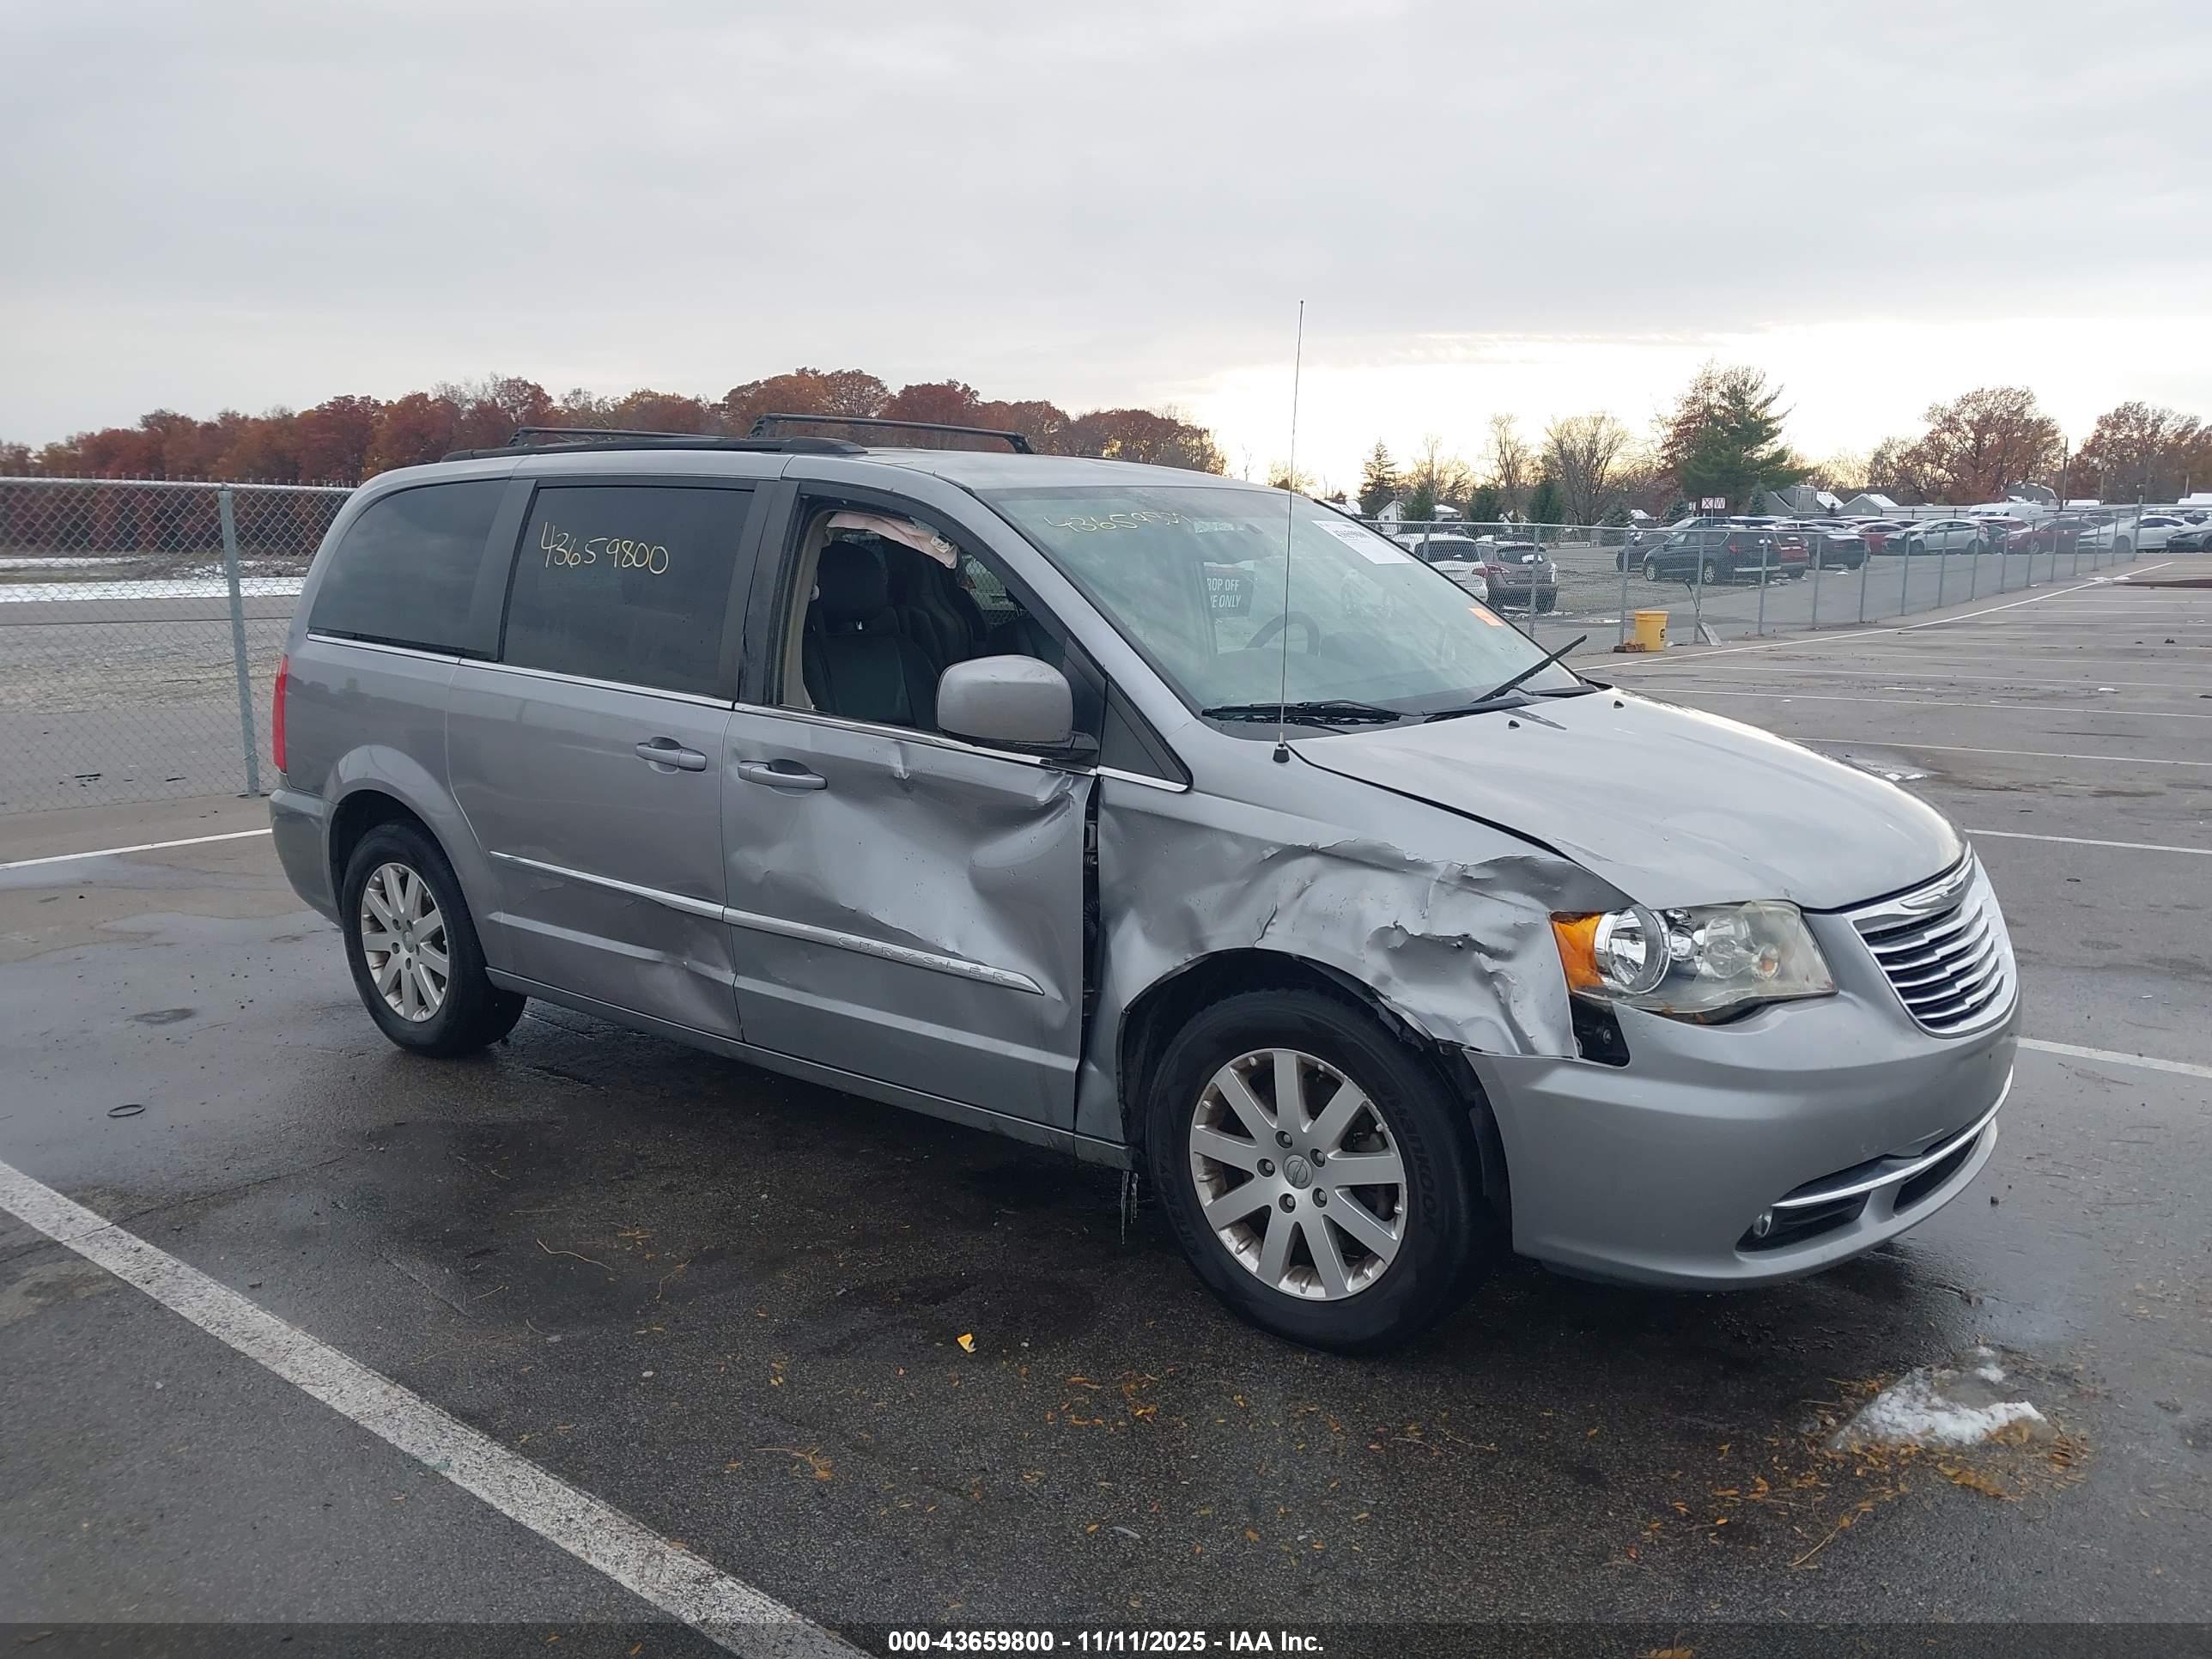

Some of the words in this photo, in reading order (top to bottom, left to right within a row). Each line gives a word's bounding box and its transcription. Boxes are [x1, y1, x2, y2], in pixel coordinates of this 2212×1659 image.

[540, 521, 669, 574] 43659800
[1224, 578, 1240, 592] OFF
[1218, 594, 1242, 608] ONLY
